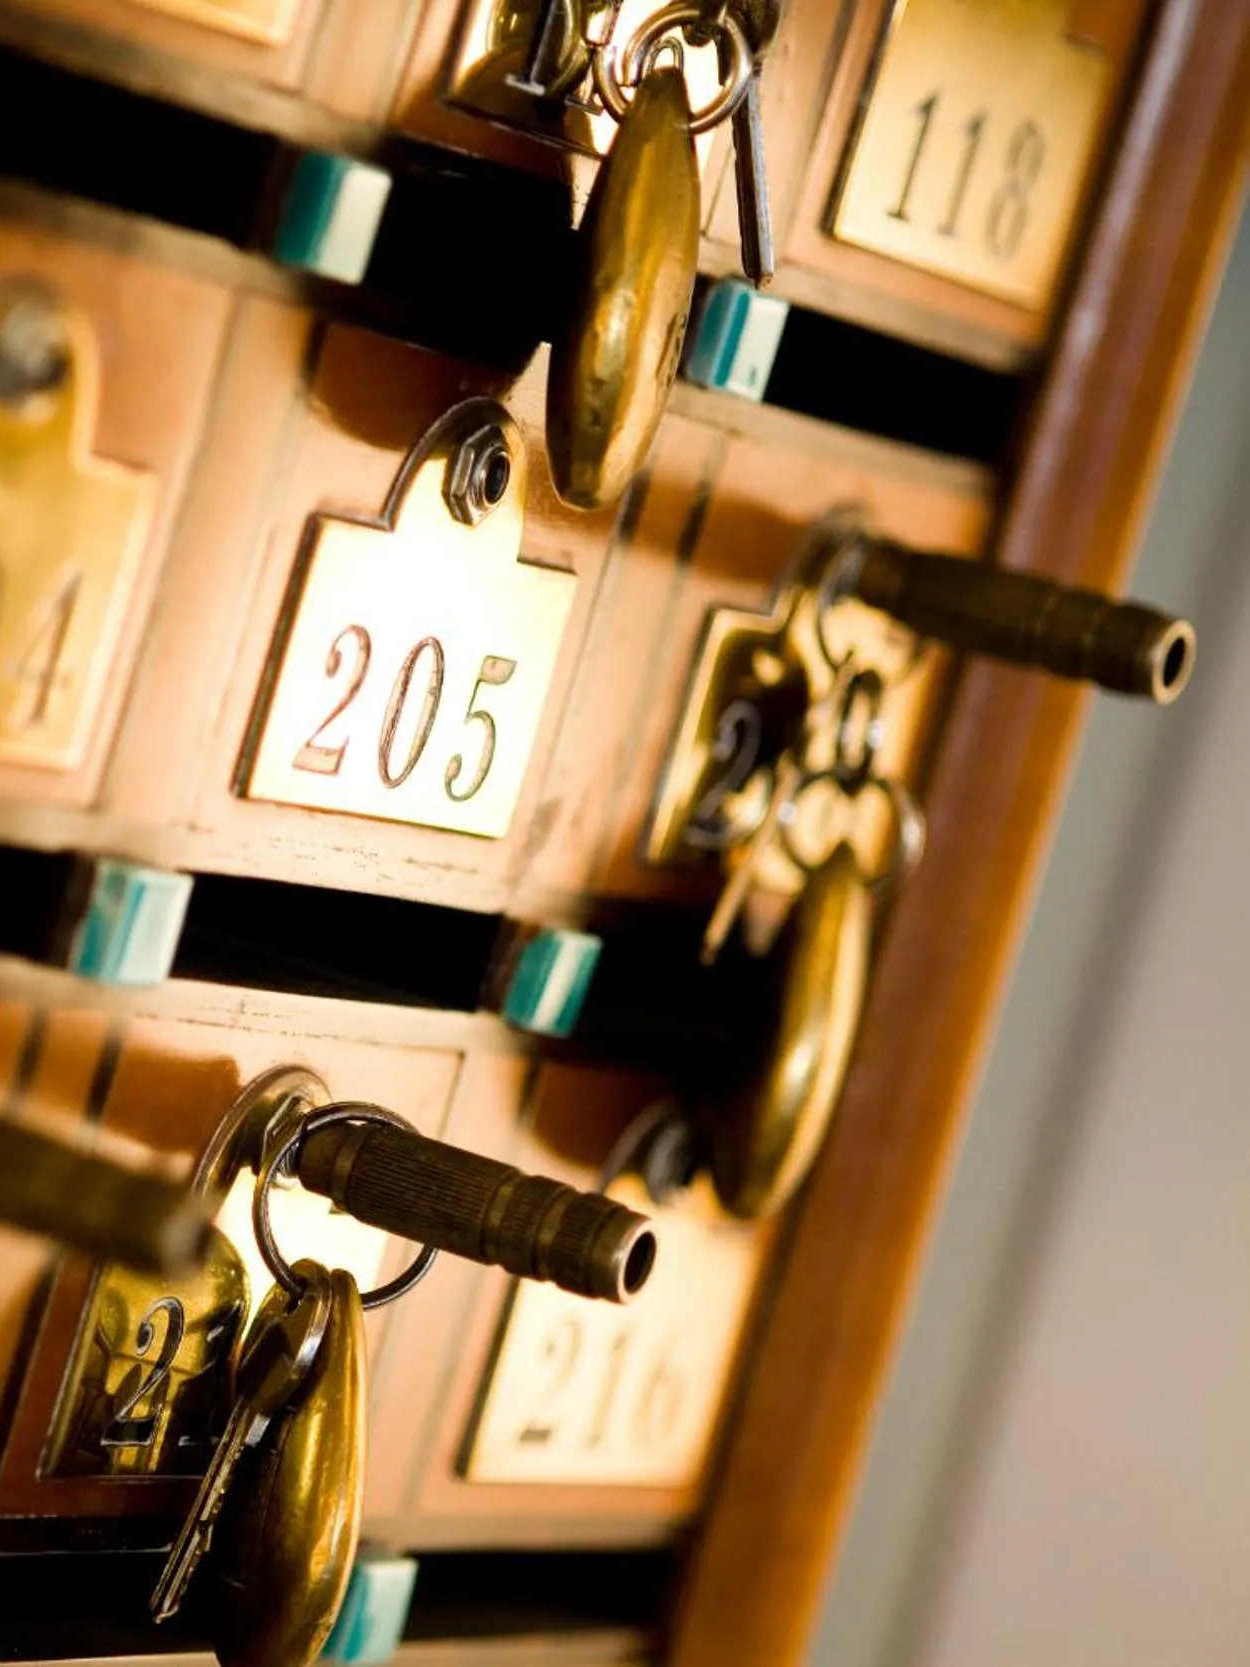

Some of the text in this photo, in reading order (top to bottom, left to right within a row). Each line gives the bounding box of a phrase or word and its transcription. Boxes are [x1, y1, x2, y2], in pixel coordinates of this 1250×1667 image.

[885, 89, 1047, 263] 118
[291, 624, 517, 802] 205
[518, 1312, 690, 1450] 216
